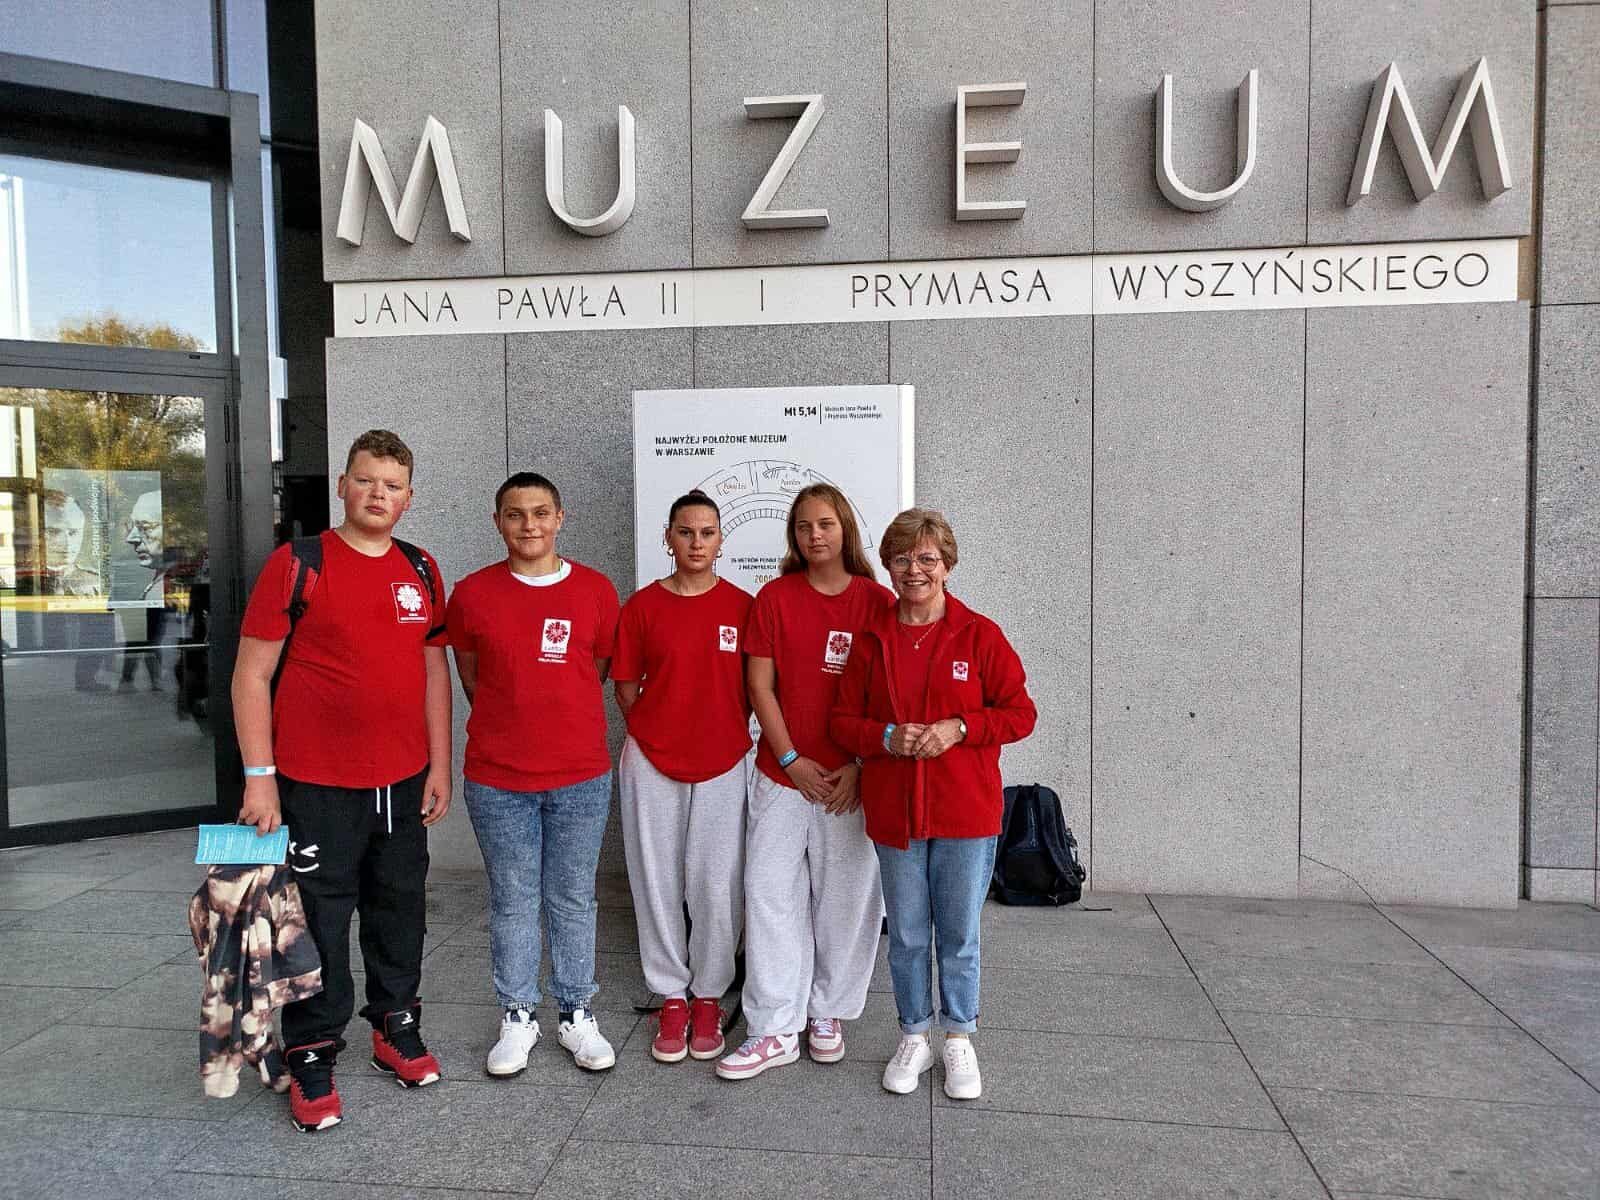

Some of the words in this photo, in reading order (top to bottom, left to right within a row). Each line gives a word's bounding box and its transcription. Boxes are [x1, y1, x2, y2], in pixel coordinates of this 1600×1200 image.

[336, 56, 1512, 247] MUZEUM
[353, 290, 459, 326] JANA
[498, 284, 627, 320] PAWŁA
[660, 282, 678, 315] II
[851, 268, 1052, 309] PRYMASA
[1109, 250, 1490, 301] WYSZYŃSKIEGO
[784, 406, 797, 417] Mt
[799, 406, 817, 418] 5,14
[655, 434, 700, 445] NAJWYŻEJ
[702, 433, 747, 444] POŁOŻONE
[749, 434, 787, 443] MUZEUM
[655, 448, 663, 456] W
[665, 447, 715, 456] WARSZAWIE
